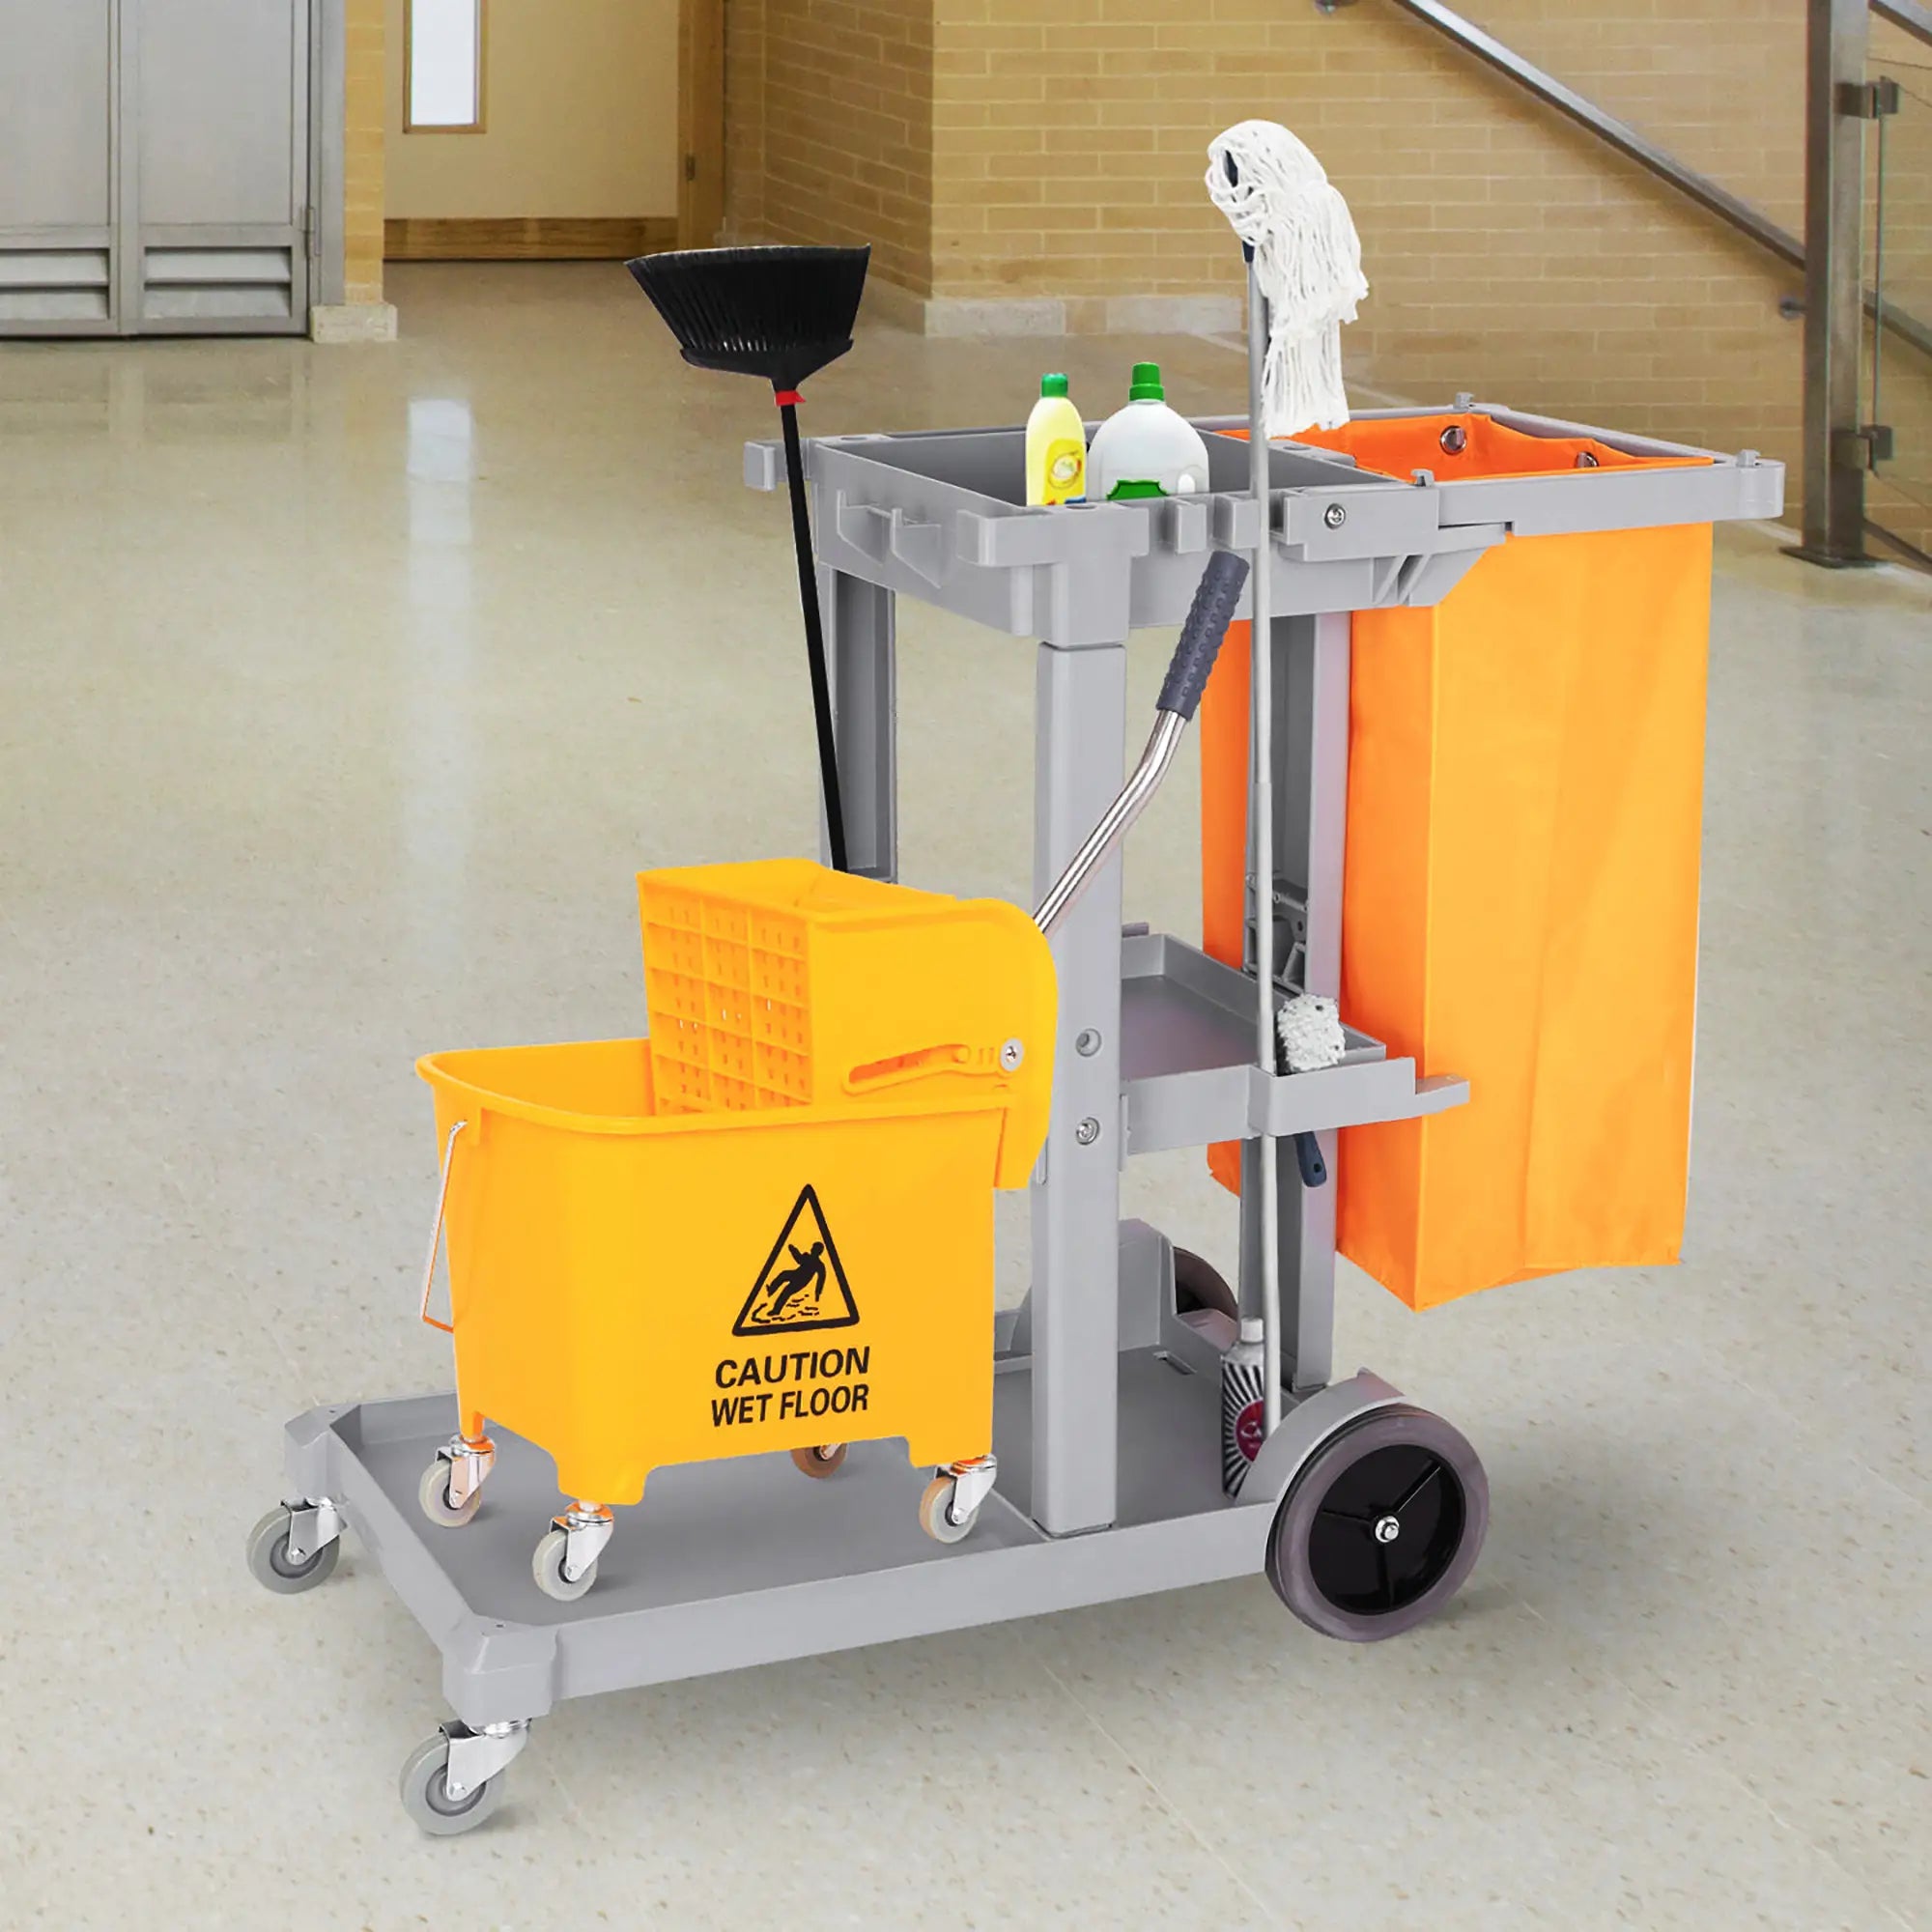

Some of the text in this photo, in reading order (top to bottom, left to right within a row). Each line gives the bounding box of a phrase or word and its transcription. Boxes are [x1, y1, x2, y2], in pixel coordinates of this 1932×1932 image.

[715, 1346, 870, 1389] CAUTION
[711, 1383, 869, 1427] WET FLOOR
